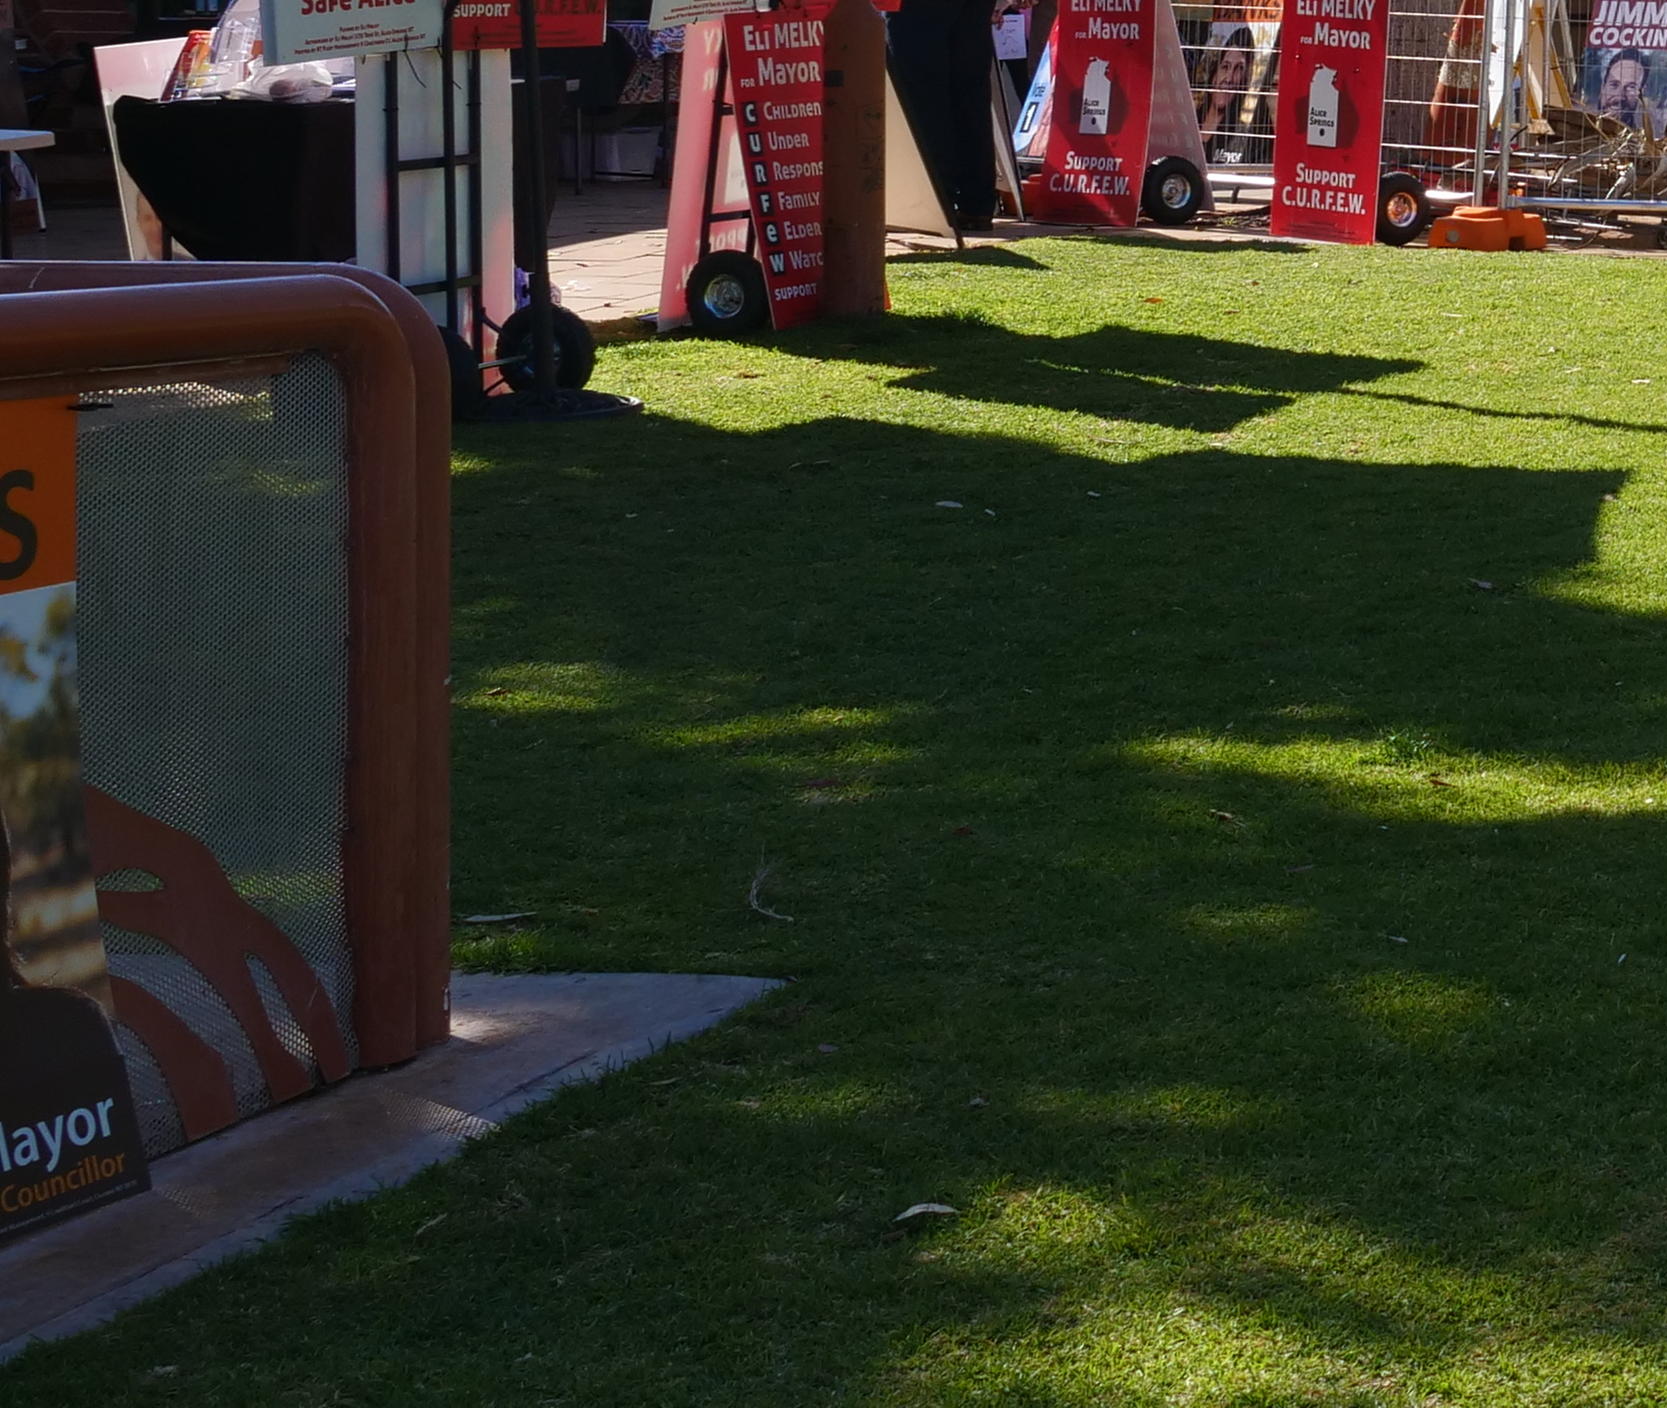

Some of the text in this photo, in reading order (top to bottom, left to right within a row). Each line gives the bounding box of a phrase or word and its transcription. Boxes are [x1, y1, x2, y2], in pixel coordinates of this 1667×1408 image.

[1050, 175, 1130, 196] C.U.R.F.E.W.
[1282, 189, 1366, 215] C.U.R.F.E.W.
[0, 1152, 126, 1212] Councillor
